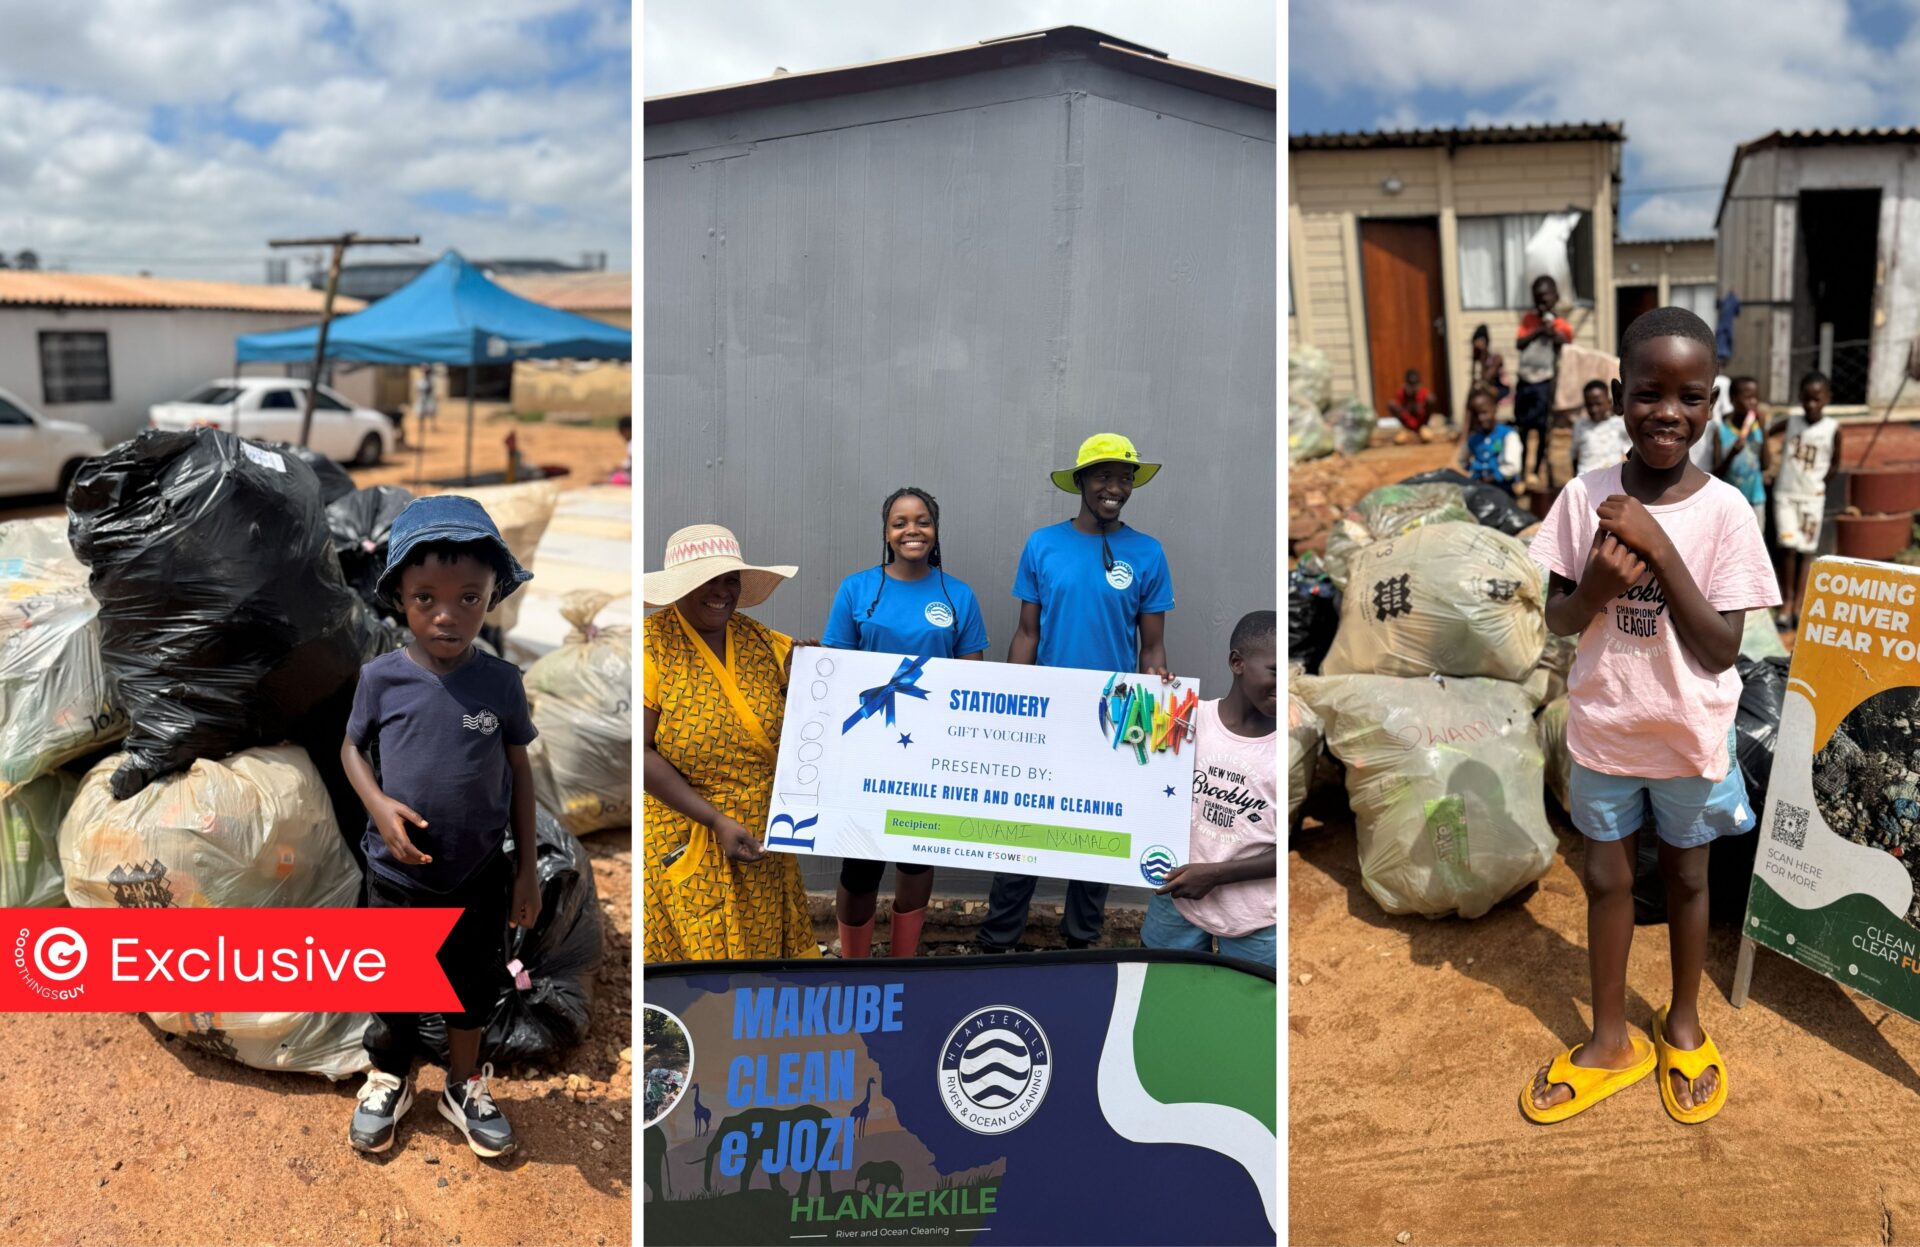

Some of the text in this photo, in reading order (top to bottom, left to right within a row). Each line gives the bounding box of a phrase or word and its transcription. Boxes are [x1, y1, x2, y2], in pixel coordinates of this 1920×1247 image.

[1814, 572, 1916, 606] COMING
[1615, 605, 1656, 619] CHAMPIONS
[1616, 615, 1658, 638] LEAGUE
[1808, 598, 1910, 634] A RIVER
[1804, 622, 1872, 654] NEAR
[949, 689, 1050, 718] STATIONERY
[947, 725, 1046, 745] GIFT VOUCHER
[931, 758, 1052, 781] PRESENTED BY:
[1208, 765, 1247, 785] NEW YORK
[863, 778, 1123, 817] HLANZEKILE RIVER AND OCEAN CLEANING
[1192, 769, 1269, 815] Brooklyn
[1202, 806, 1235, 828] LEAGUE
[1204, 800, 1237, 817] CHAMPIONS
[892, 817, 941, 831] Recipient:
[912, 844, 952, 855] MAKUBE
[954, 848, 984, 859] CLEAN
[1046, 829, 1121, 853] NXUMALO
[1765, 861, 1818, 892] FOR MORE
[1767, 847, 1823, 879] SCAN HERE
[122, 881, 157, 899] PIKI
[1852, 935, 1899, 965] CLEAR
[1866, 926, 1915, 957] CLEAN
[732, 983, 904, 1040] MAKUBE
[947, 1014, 1045, 1061] HLANZEKILE
[726, 1048, 855, 1108] CLEAN
[947, 1069, 1043, 1127] RIVER & OCEAN CLEANING
[790, 1187, 998, 1222] HLANZEKILE
[836, 1226, 950, 1239] River and Ocean Cleaning
